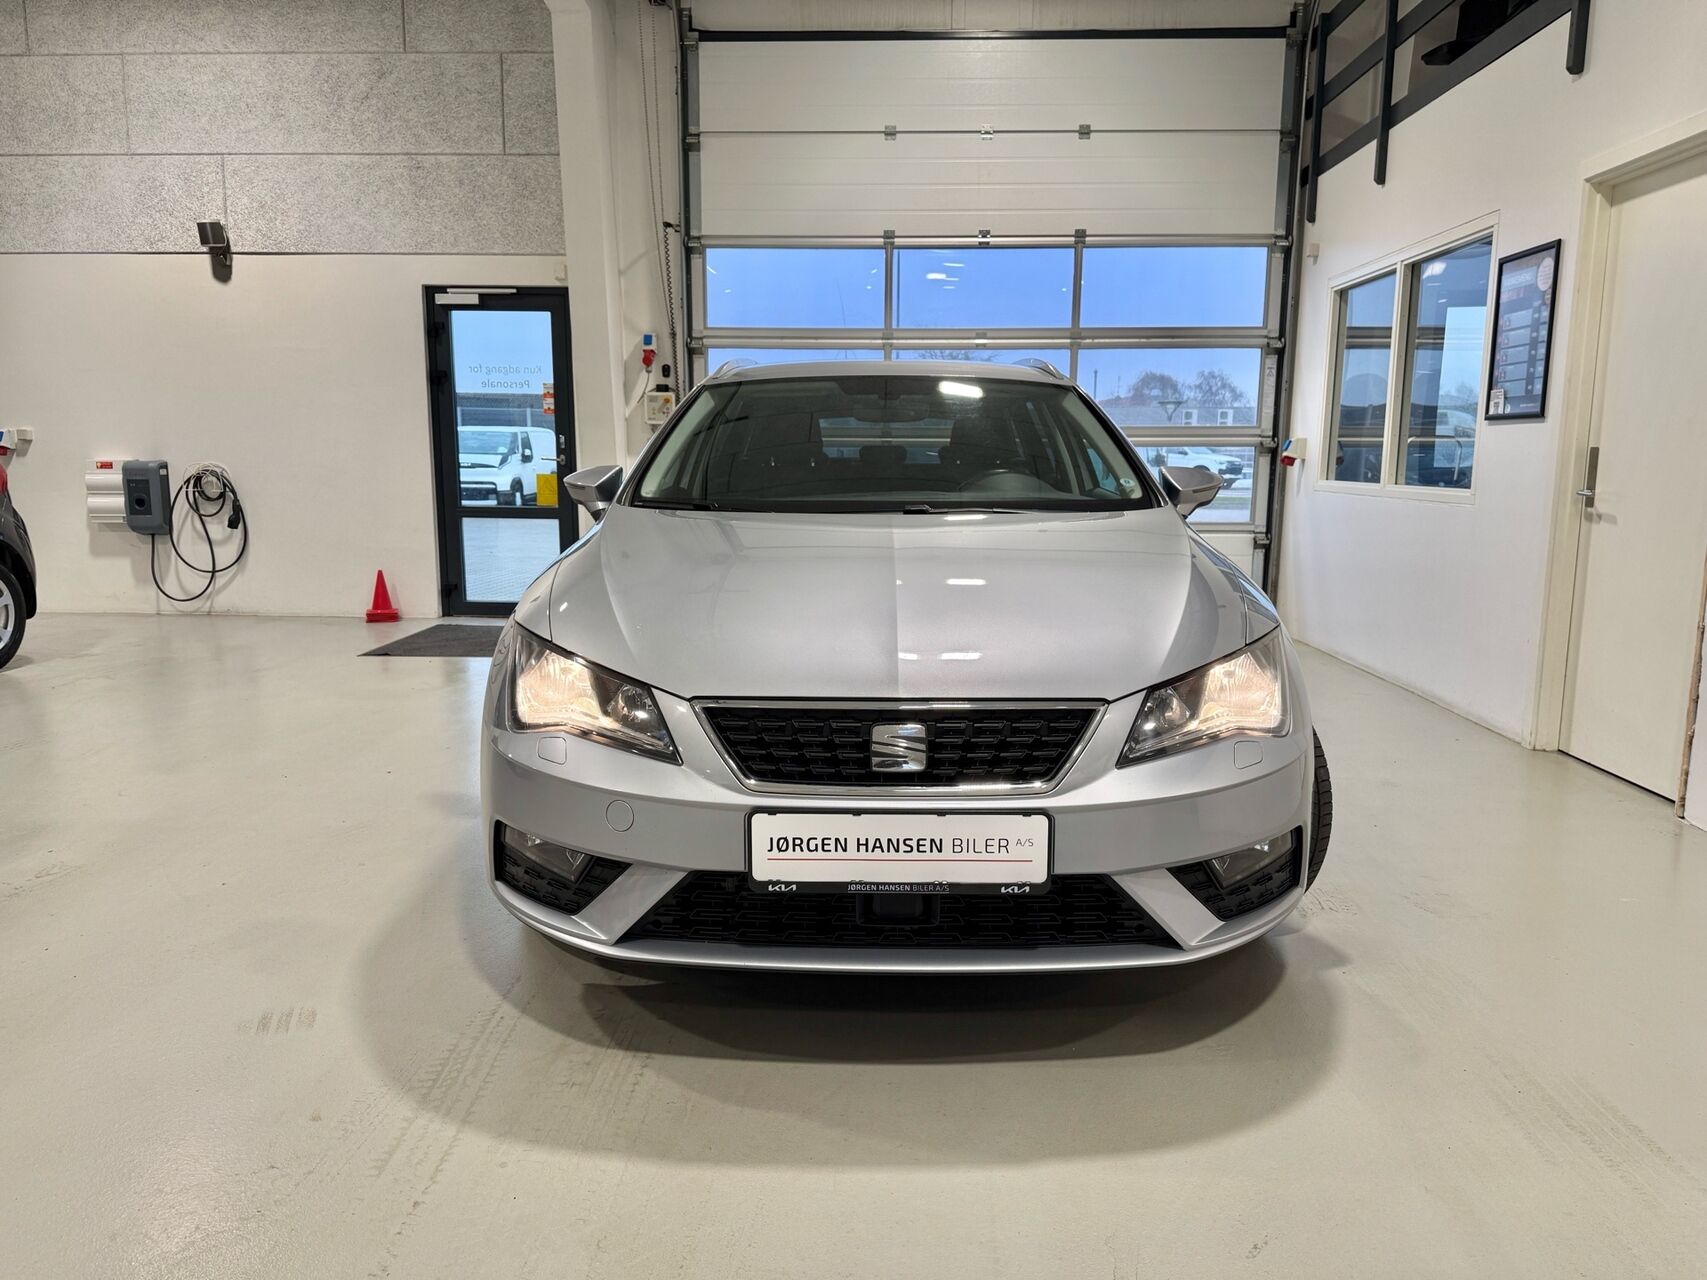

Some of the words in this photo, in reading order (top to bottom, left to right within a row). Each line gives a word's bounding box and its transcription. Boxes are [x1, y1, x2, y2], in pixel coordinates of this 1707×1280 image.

[767, 836, 848, 854] JØRGEN
[856, 837, 943, 854] HANSEN
[951, 837, 1010, 854] BILER
[1015, 838, 1034, 848] A/S
[847, 883, 877, 892] JØRGEN
[878, 884, 911, 892] HANSEN
[912, 884, 934, 893] BILER
[935, 884, 950, 893] A/S
